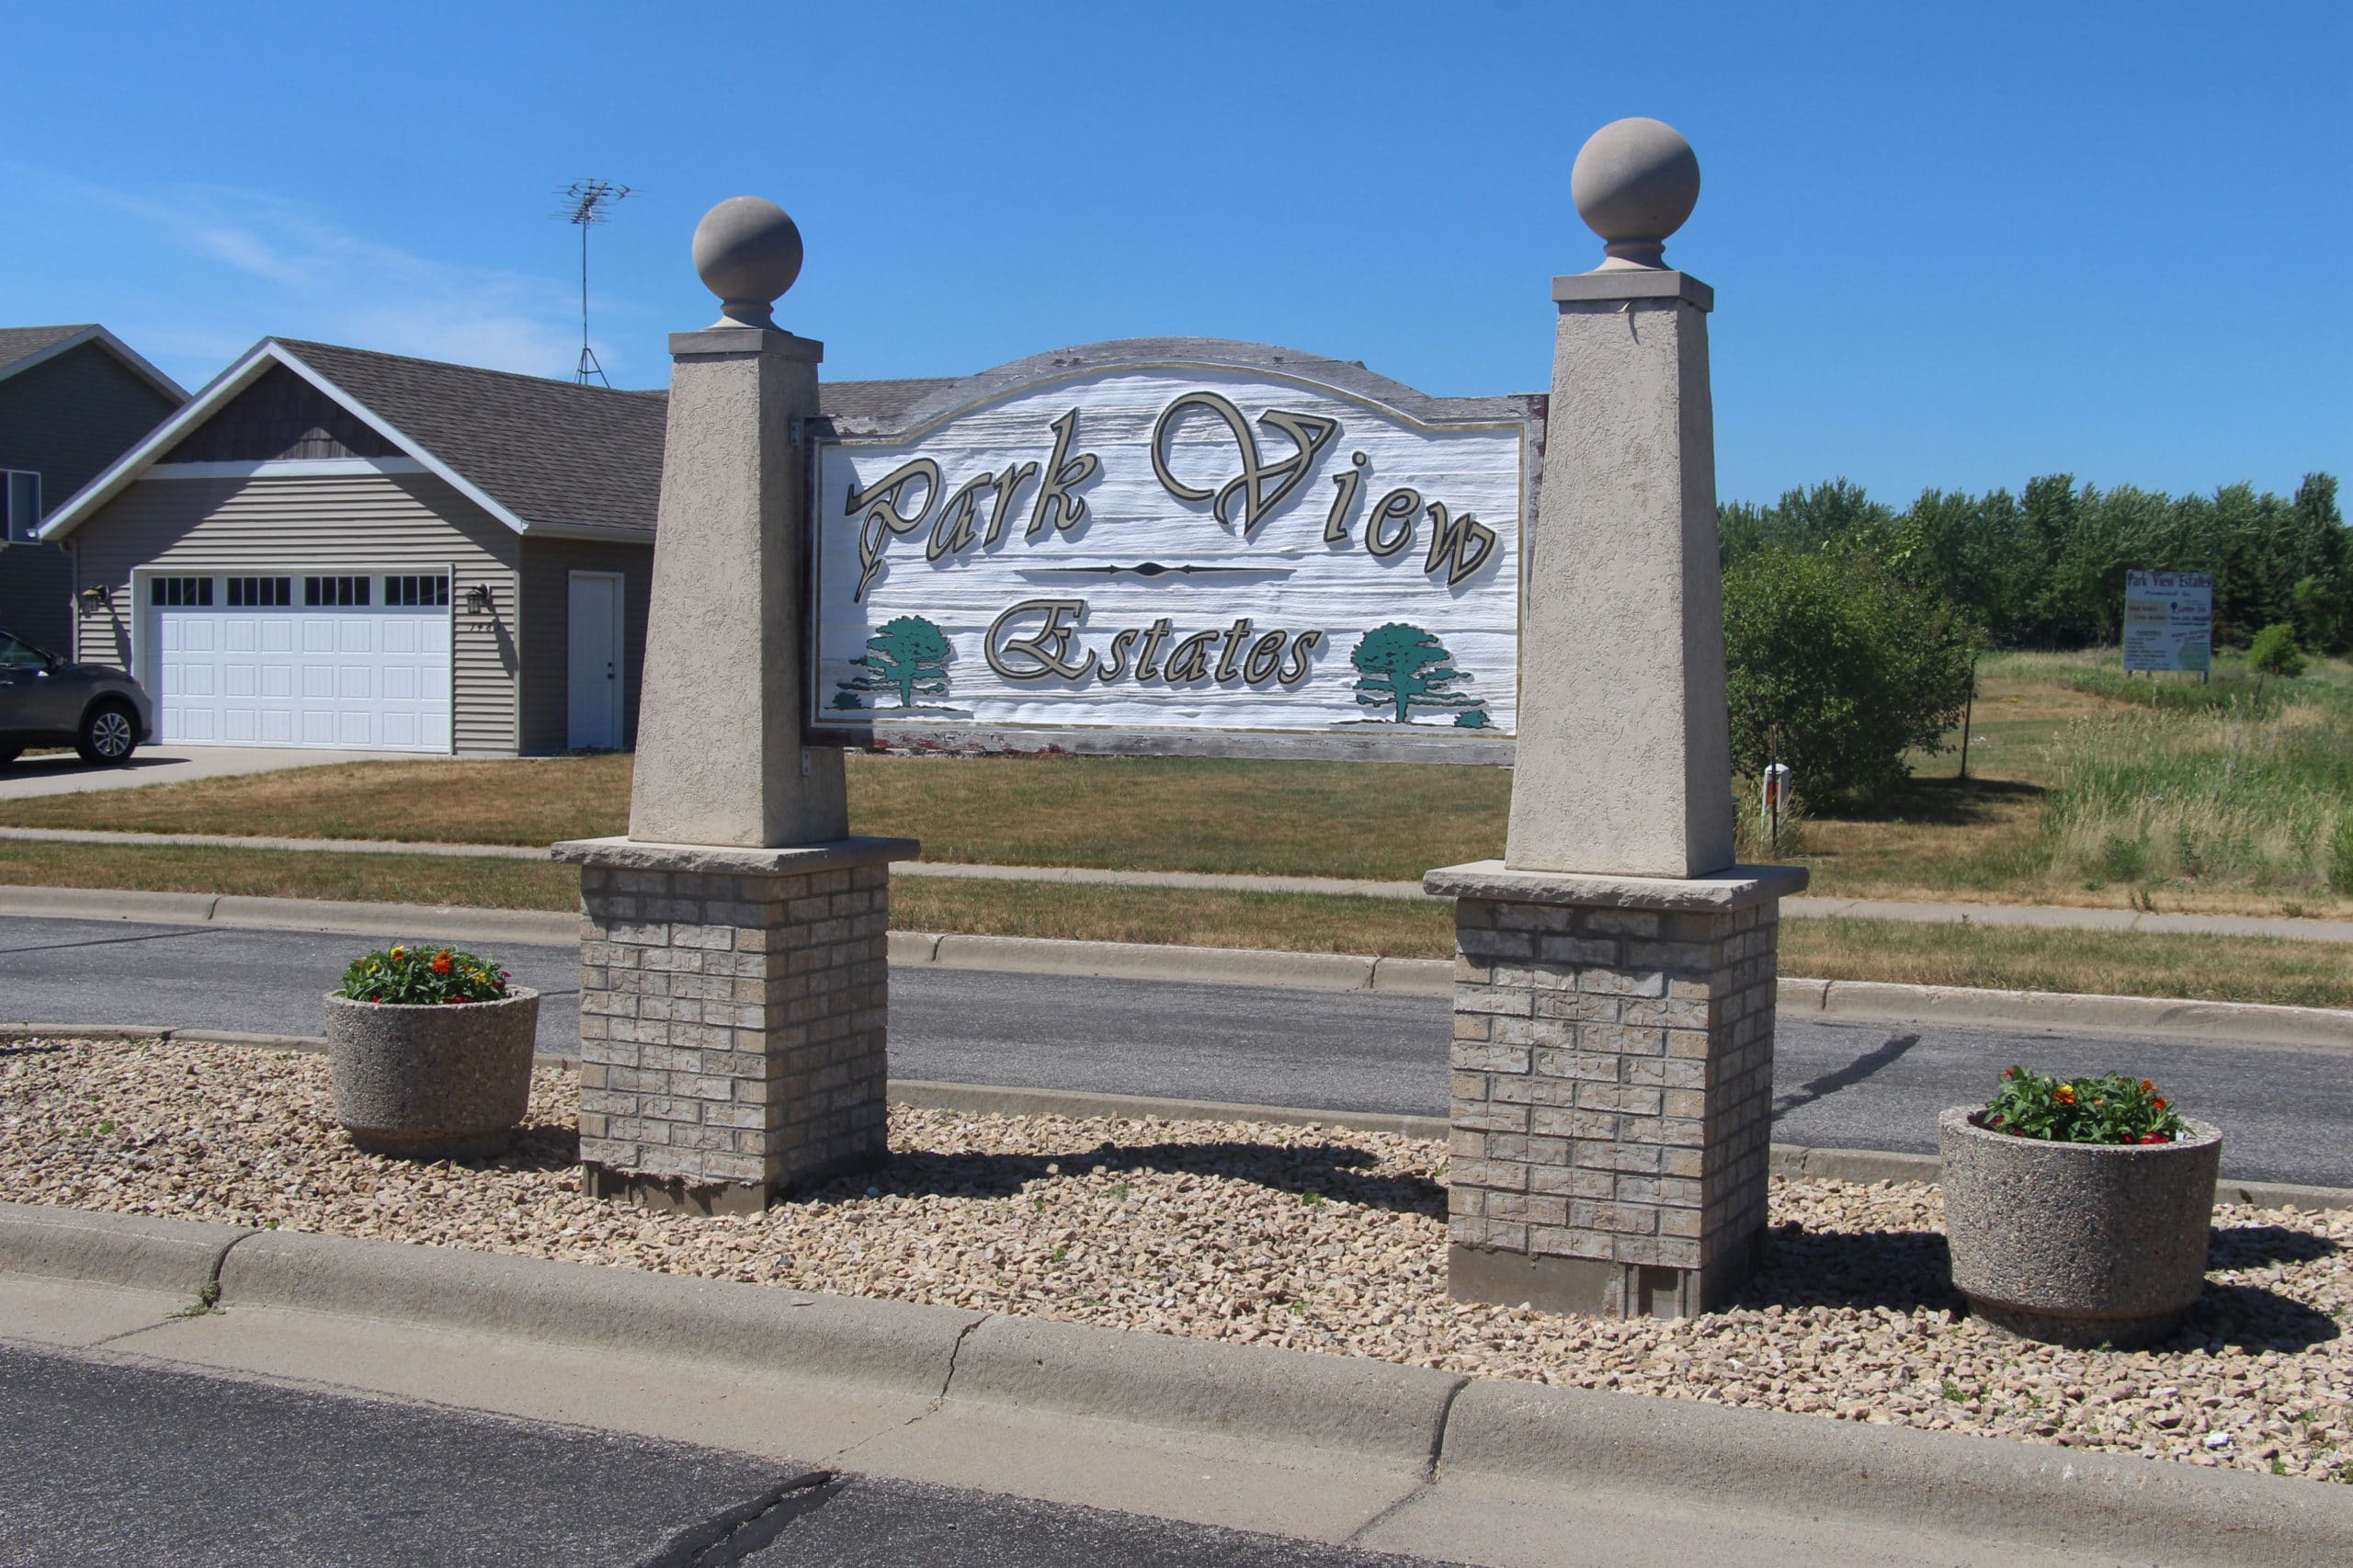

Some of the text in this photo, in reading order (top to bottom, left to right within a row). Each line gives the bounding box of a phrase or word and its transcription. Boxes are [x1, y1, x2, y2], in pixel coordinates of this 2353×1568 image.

[845, 391, 1496, 603] Park View
[2128, 573, 2211, 588] Park View Estates
[983, 599, 1322, 686] Estates
